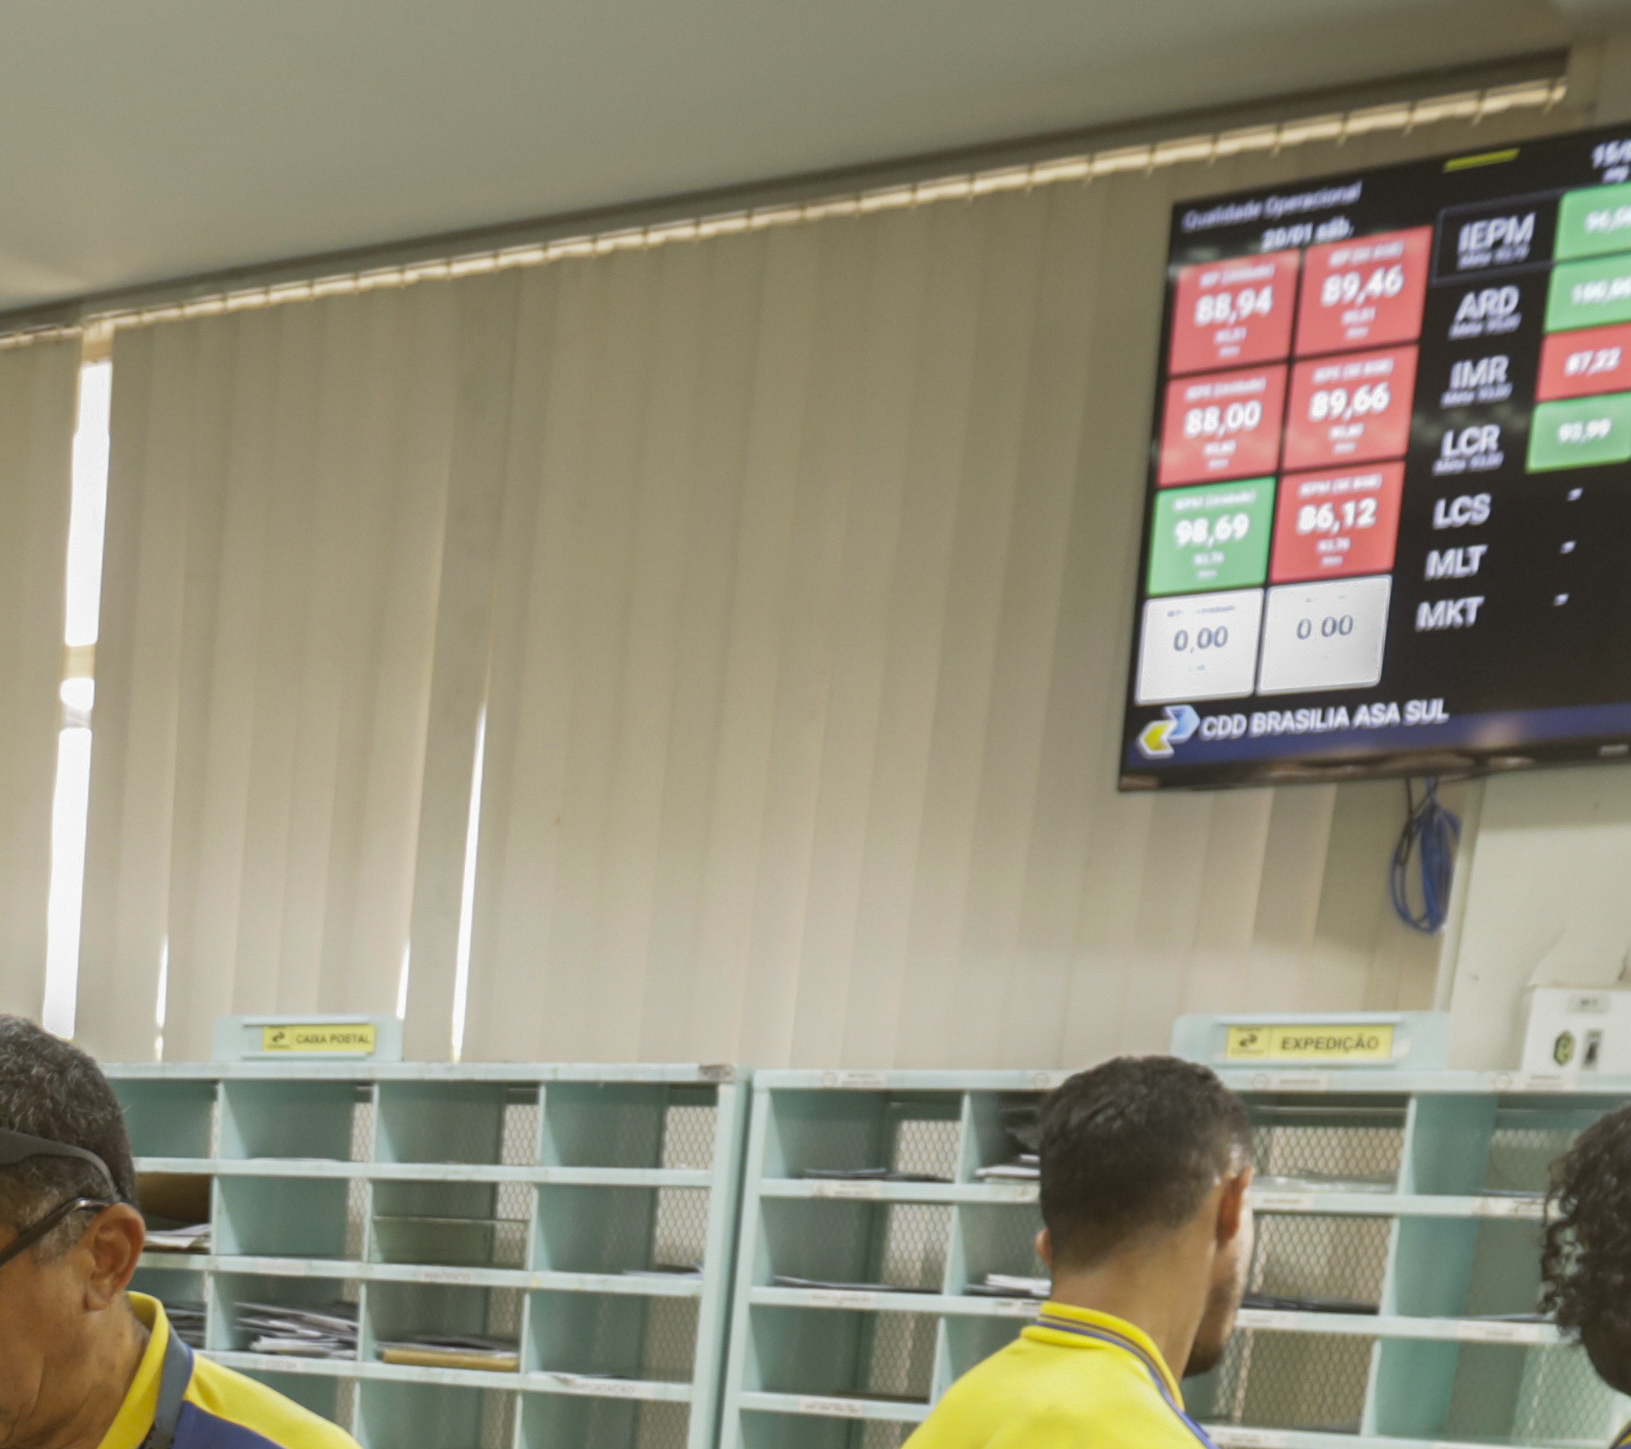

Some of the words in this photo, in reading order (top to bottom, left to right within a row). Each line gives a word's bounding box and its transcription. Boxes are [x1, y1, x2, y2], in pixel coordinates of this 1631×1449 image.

[1183, 198, 1261, 232] Qualidade
[1263, 181, 1362, 218] Operacional
[1458, 212, 1535, 252] IEPM
[1322, 265, 1404, 306] 89,46
[1454, 285, 1519, 322] ARD
[1195, 286, 1272, 326] 88,94
[1450, 355, 1509, 388] IMR
[1184, 400, 1262, 438] 88,00
[1309, 383, 1390, 421] 89,66
[1444, 424, 1500, 458] LCR
[1174, 512, 1250, 547] 98,69
[1297, 497, 1377, 534] 86,12
[1433, 494, 1491, 530] LCS
[1425, 544, 1488, 580] MLT
[1415, 596, 1484, 631] MKT
[1174, 626, 1228, 653] 0,00
[1200, 715, 1247, 740] CDD
[1251, 707, 1349, 737] BRASILIA
[1355, 703, 1401, 728] ASA
[1406, 698, 1450, 722] SUL
[296, 1033, 327, 1044] CAIXA
[330, 1032, 370, 1044] POSTAL
[1281, 1035, 1380, 1054] EXPEDIÇÃO
